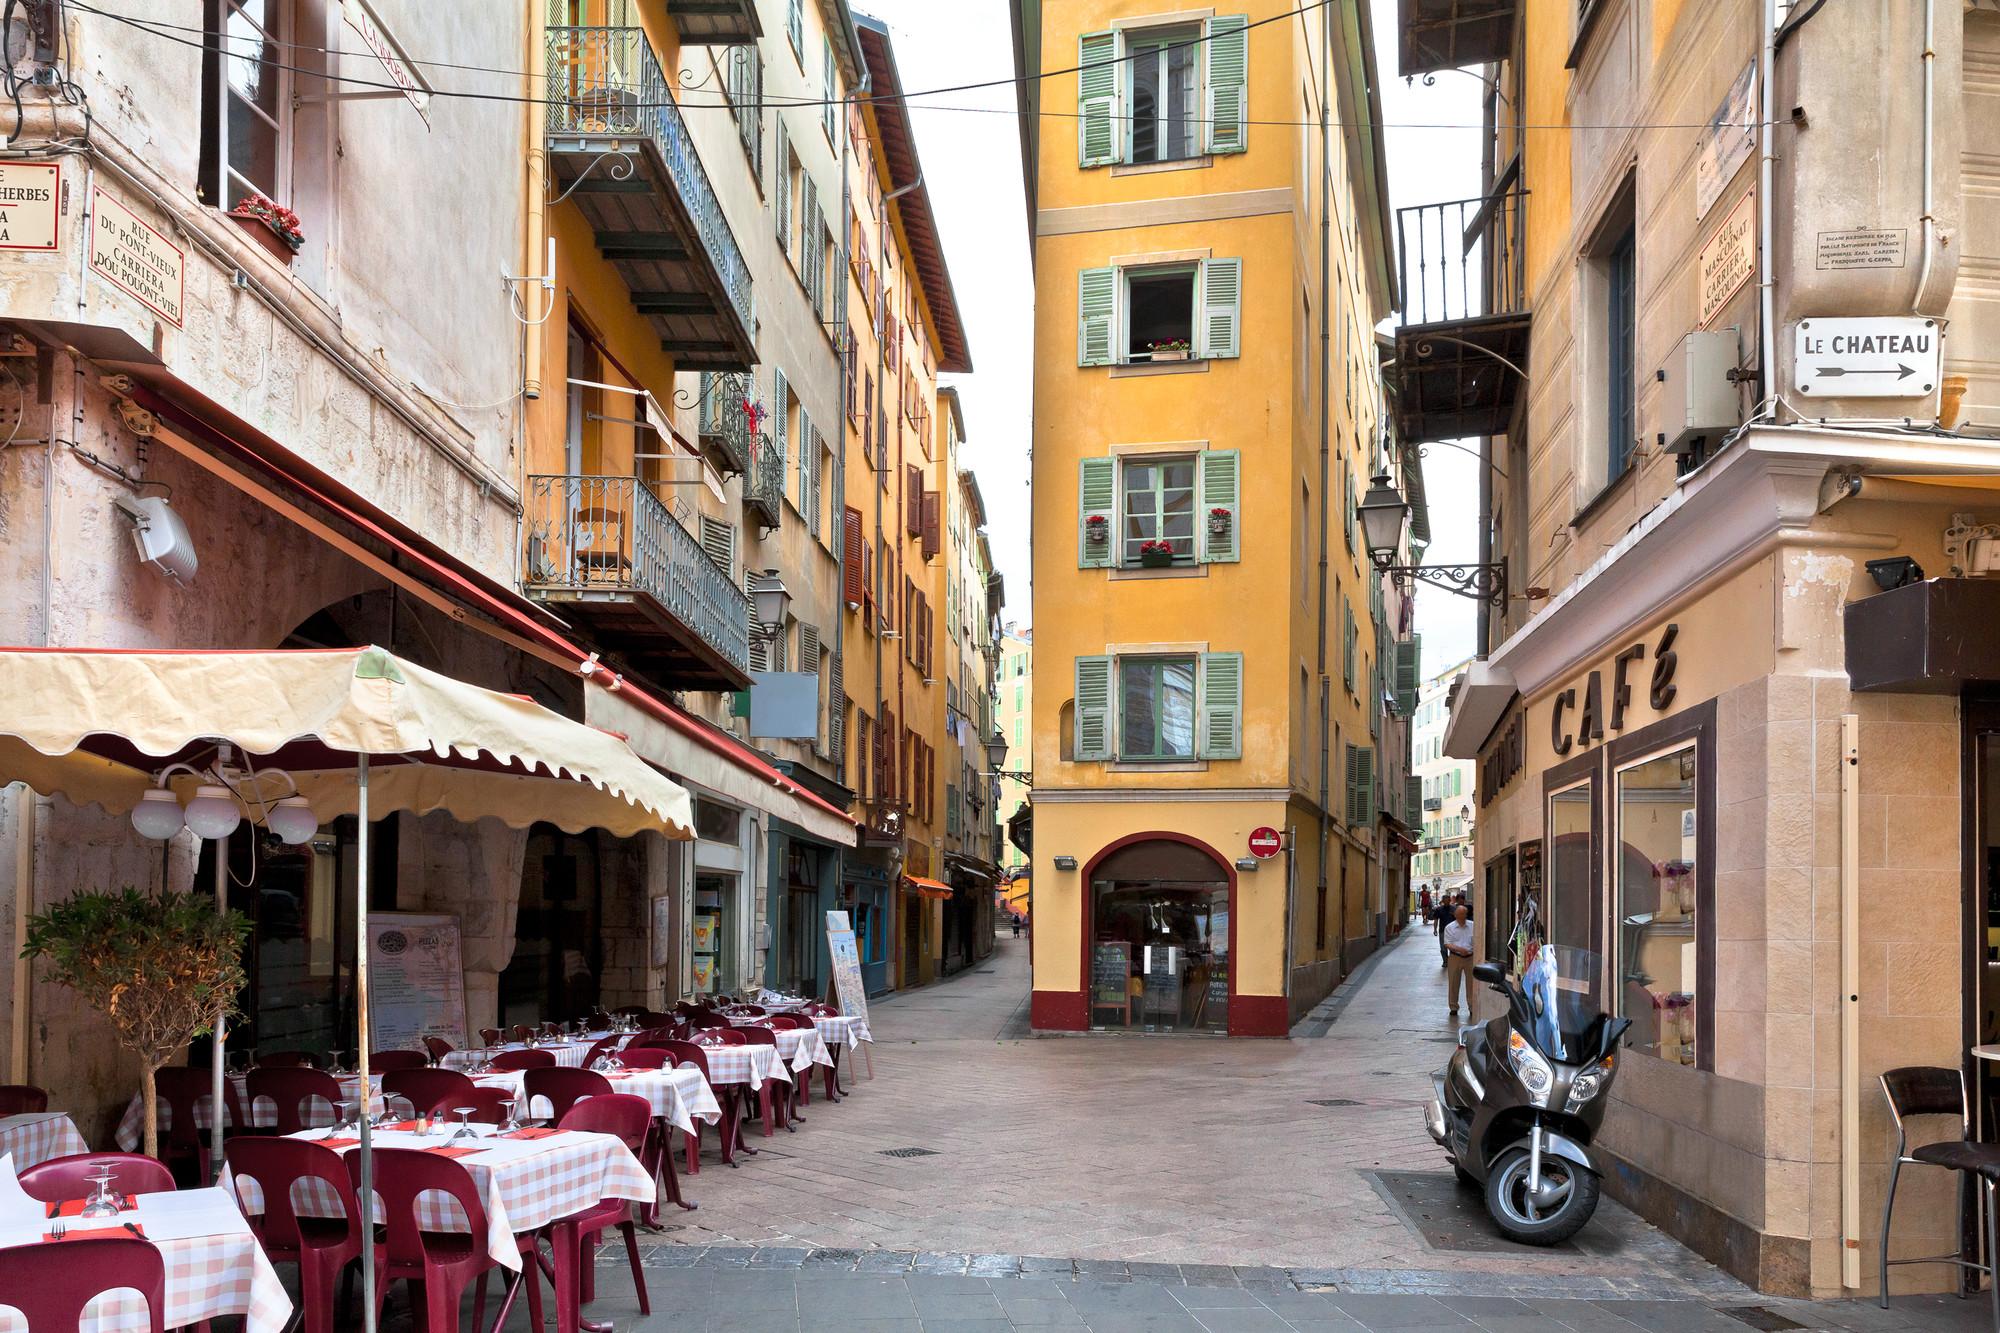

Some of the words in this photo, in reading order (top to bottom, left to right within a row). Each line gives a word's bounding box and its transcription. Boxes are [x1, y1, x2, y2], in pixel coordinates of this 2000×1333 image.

[101, 215, 116, 235] DU
[119, 228, 177, 281] PONT-VIEUX
[131, 222, 151, 245] RUE
[1718, 221, 1734, 245] RUE
[113, 247, 165, 293] CARRIERA
[1706, 246, 1745, 299] CARRIERA
[1805, 336, 1823, 354] LE
[1832, 335, 1929, 354] CHATEAU
